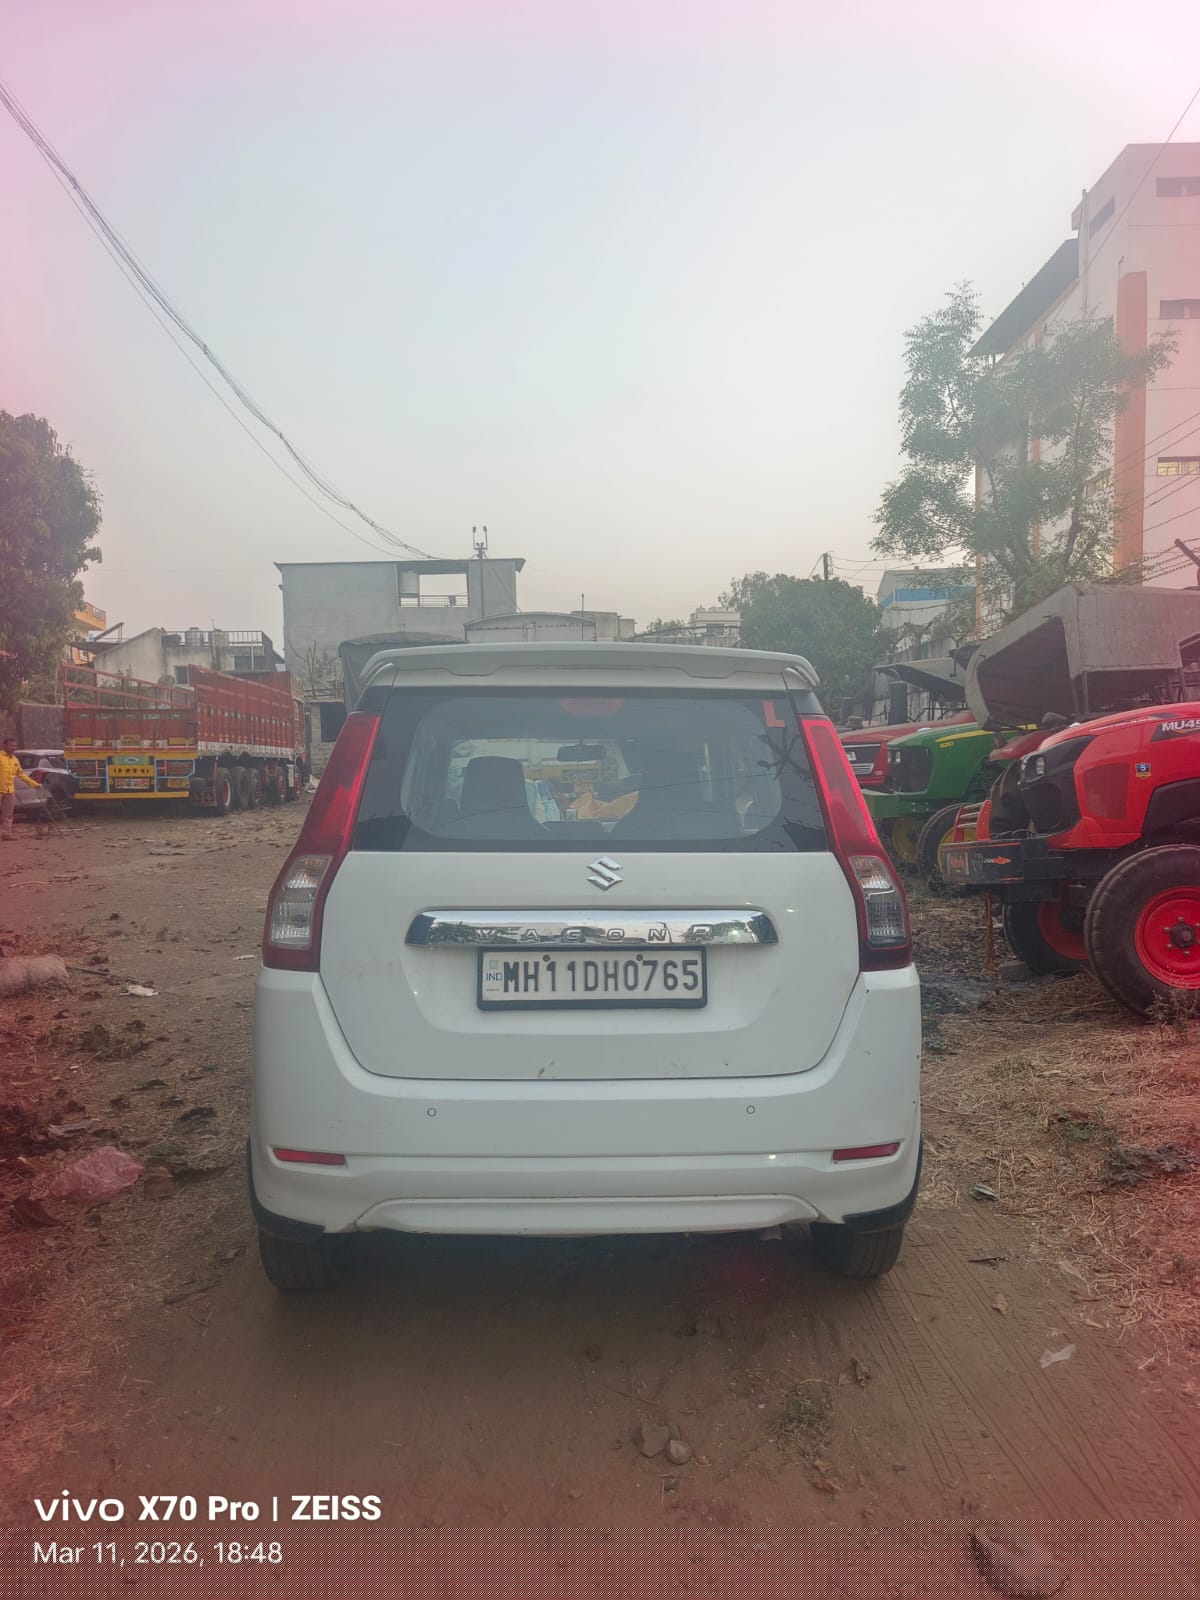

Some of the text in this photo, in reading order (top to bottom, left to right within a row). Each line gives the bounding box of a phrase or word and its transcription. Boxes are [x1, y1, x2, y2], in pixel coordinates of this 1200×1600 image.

[762, 700, 785, 728] L
[486, 971, 502, 982] IND
[503, 959, 699, 993] MH11DH0765
